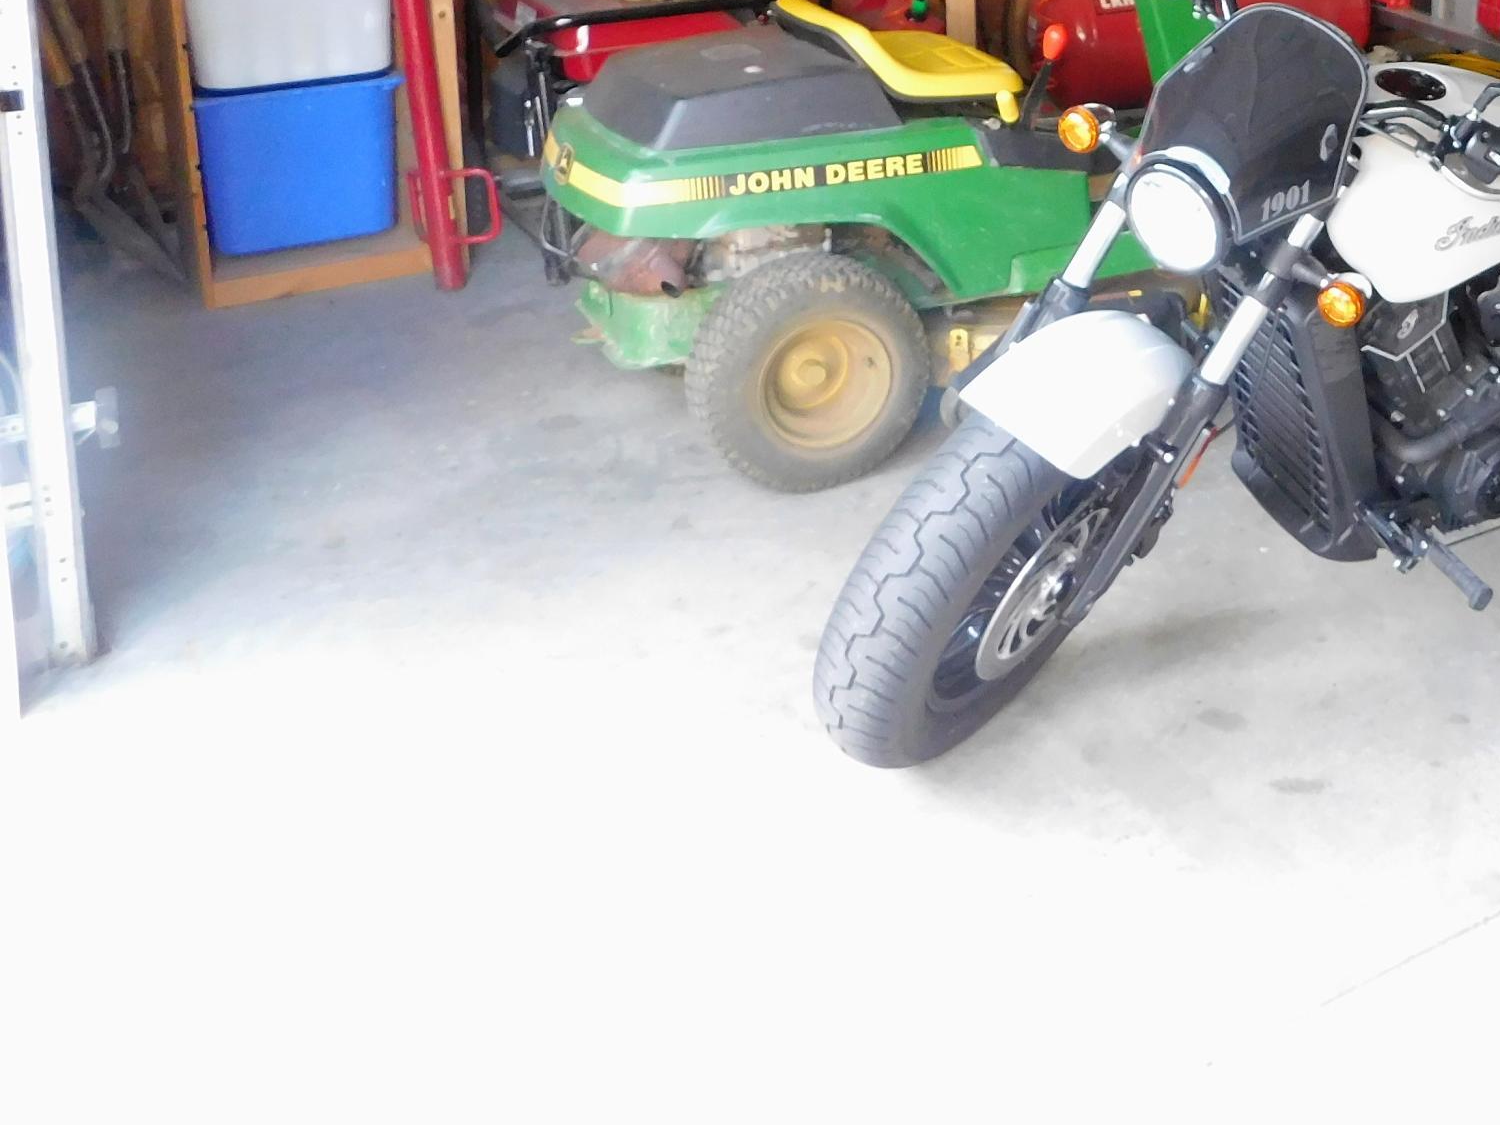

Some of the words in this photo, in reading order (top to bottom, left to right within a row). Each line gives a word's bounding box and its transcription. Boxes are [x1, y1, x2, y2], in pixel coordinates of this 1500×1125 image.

[729, 167, 815, 196] JOHN
[825, 154, 924, 185] DEERE
[1261, 179, 1310, 222] 1901
